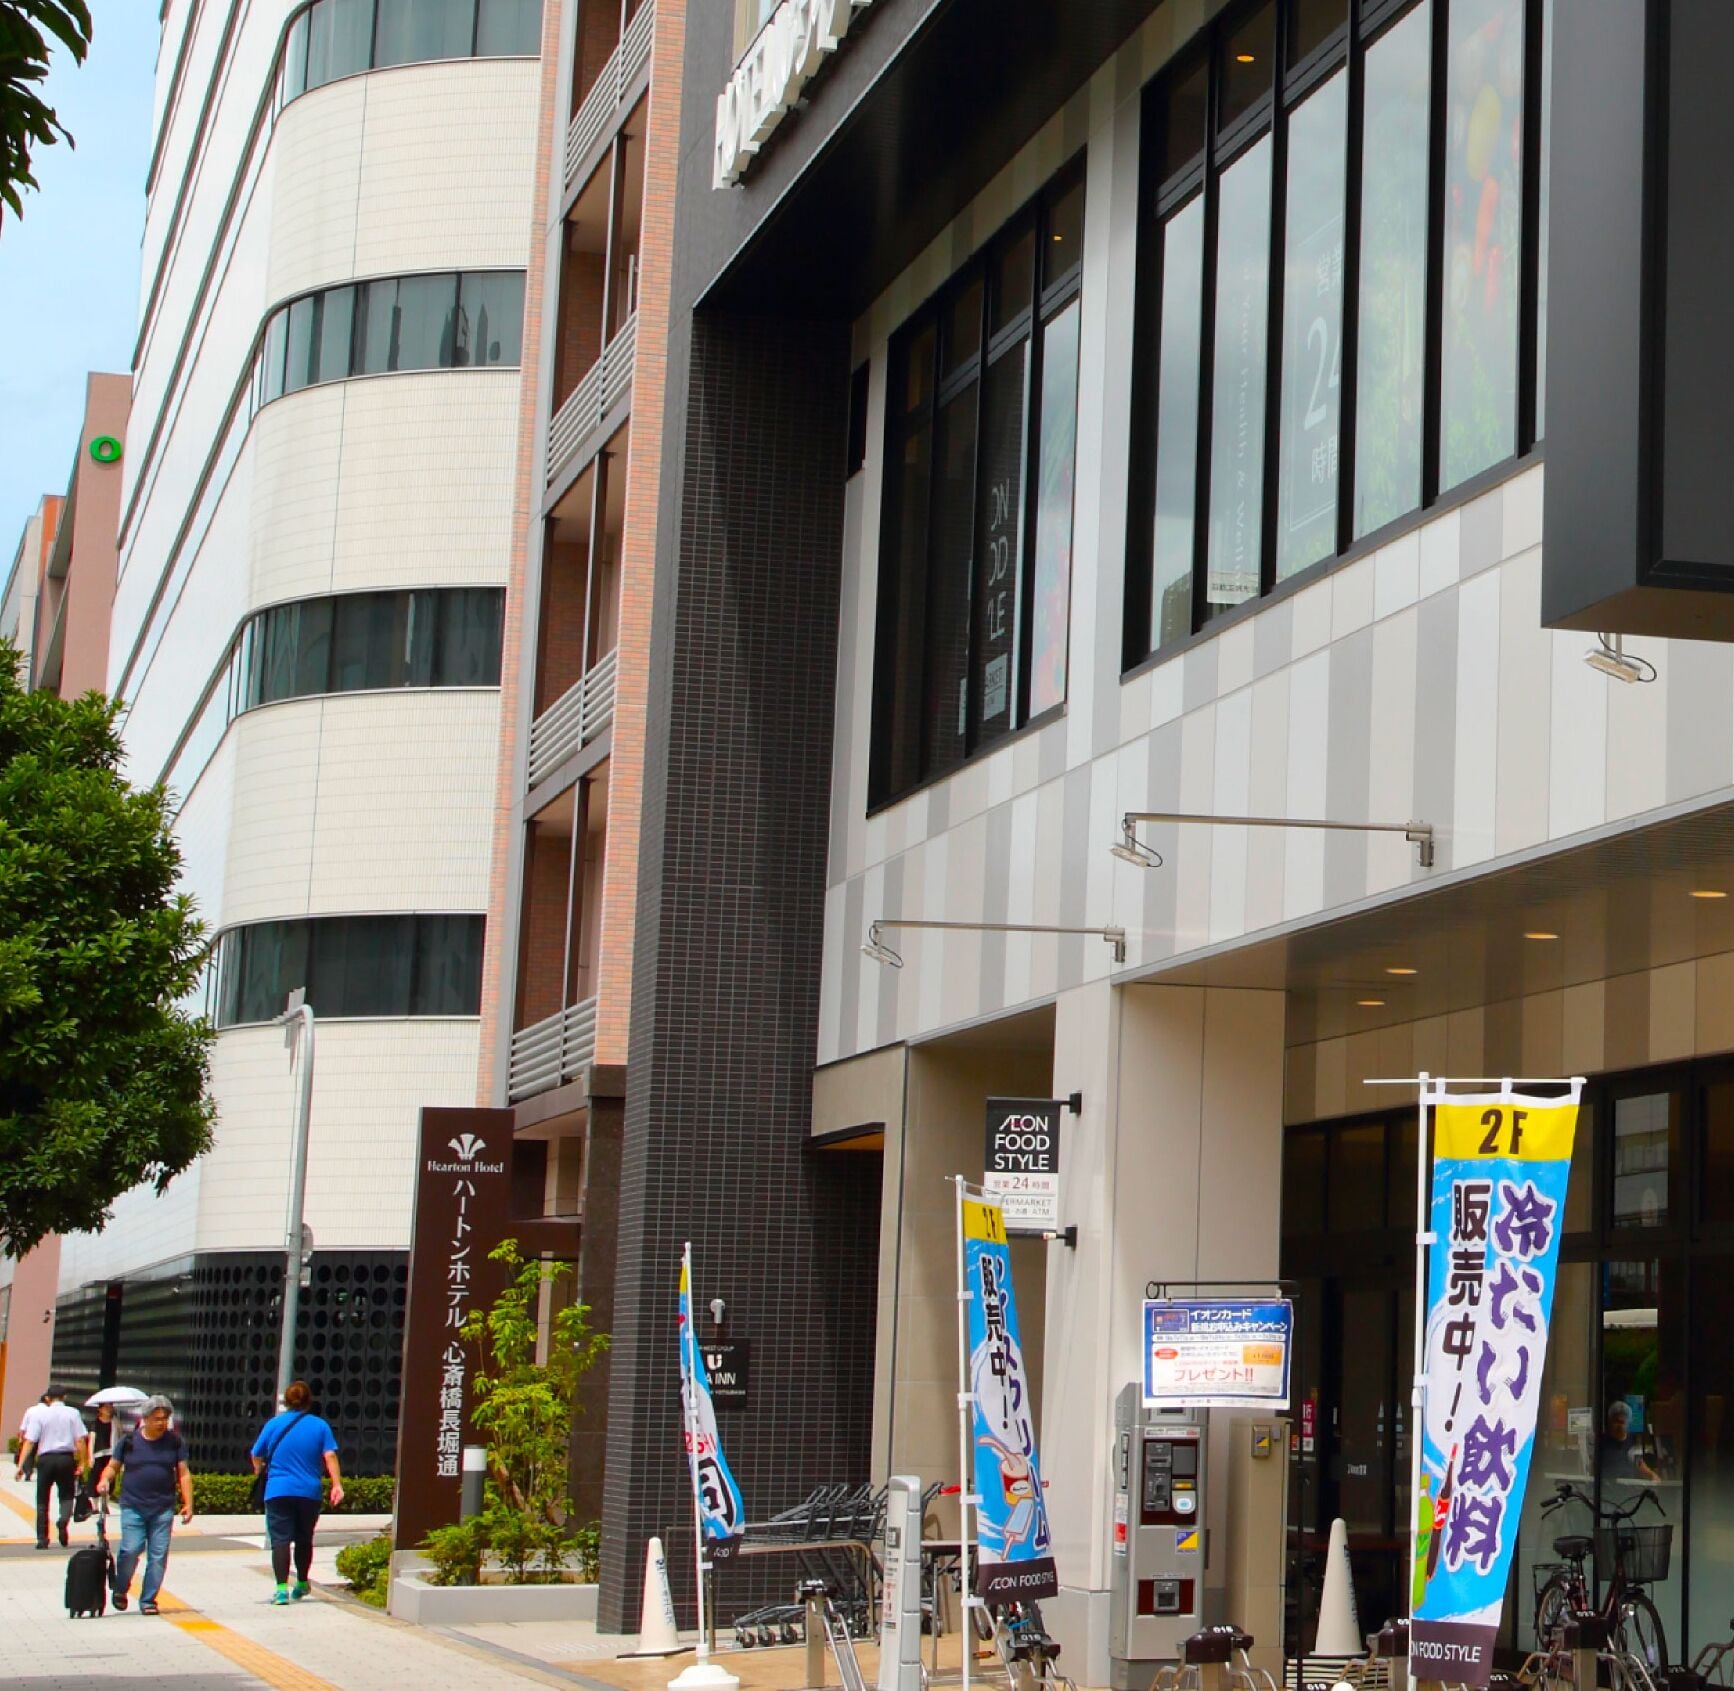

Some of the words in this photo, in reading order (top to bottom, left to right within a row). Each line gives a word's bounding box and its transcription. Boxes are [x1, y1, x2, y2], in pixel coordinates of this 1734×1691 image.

[1478, 1109, 1528, 1155] 2F
[995, 1134, 1049, 1151] FOOD
[427, 1160, 471, 1172] Hearton
[475, 1161, 504, 1173] Hotel
[995, 1154, 1049, 1170] STYLE
[1444, 1644, 1481, 1663] STYLE
